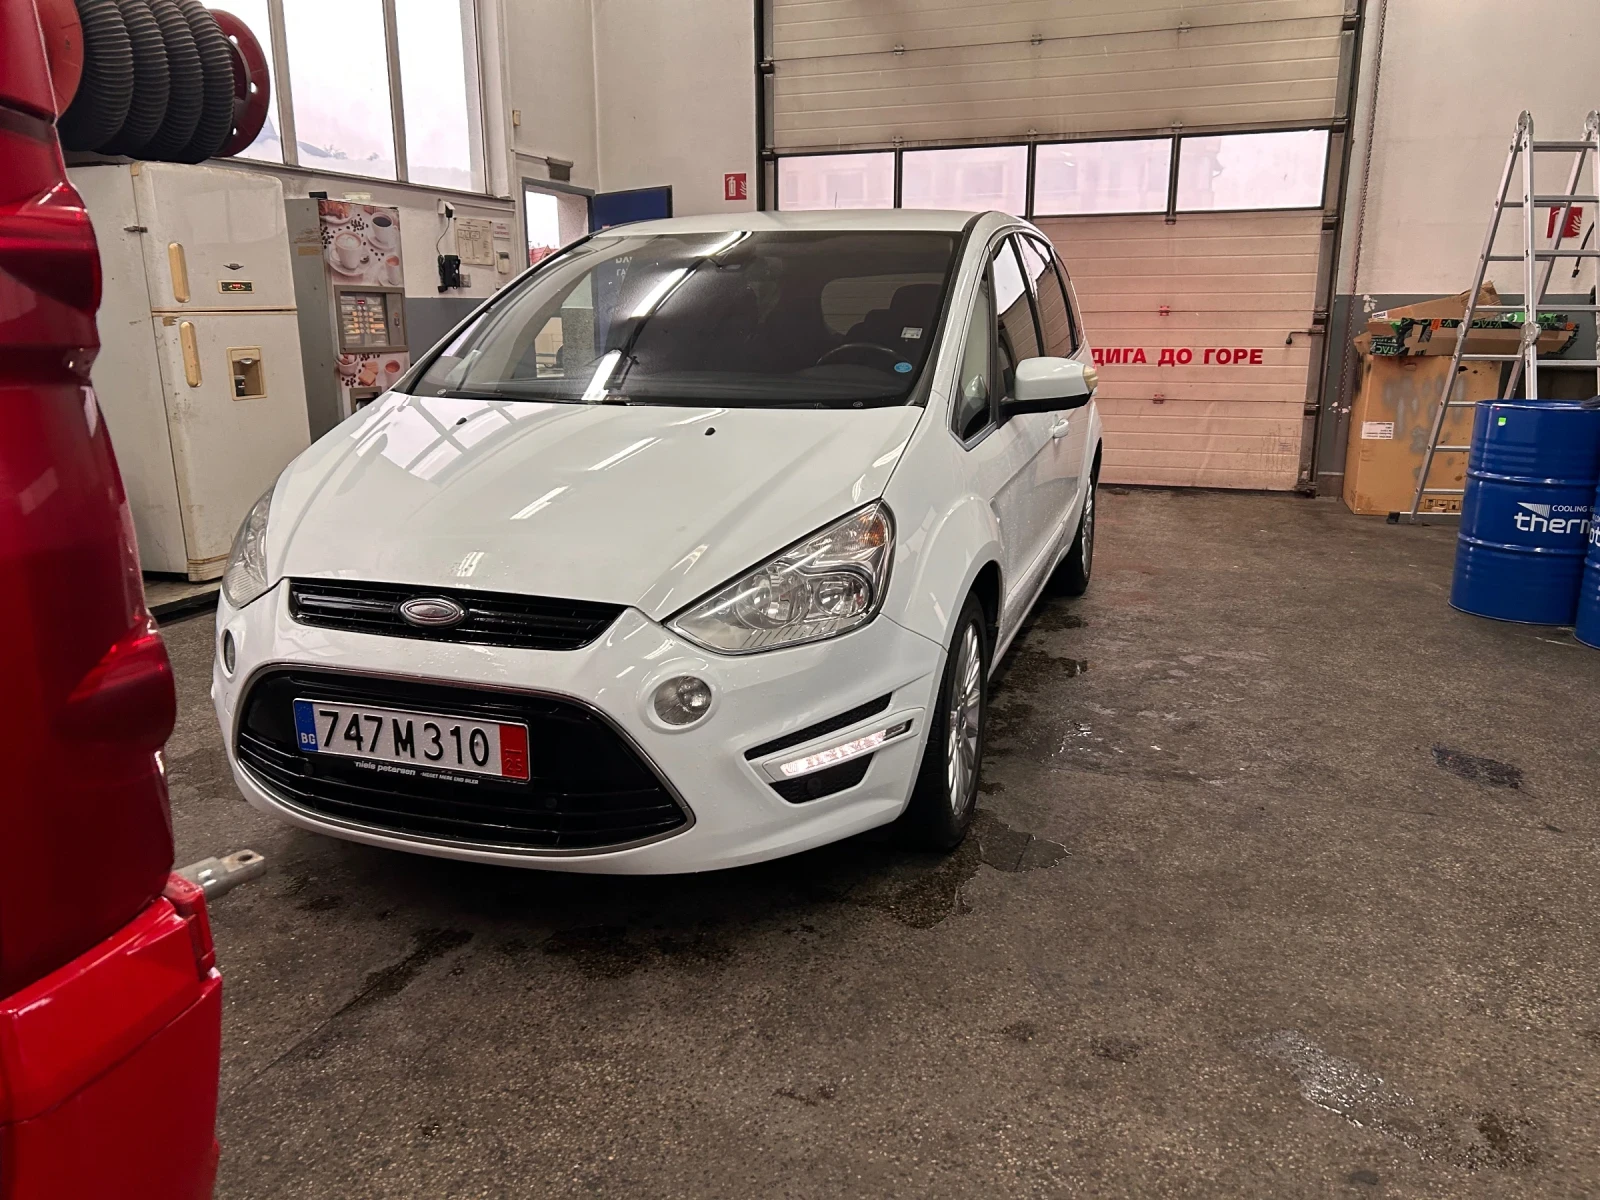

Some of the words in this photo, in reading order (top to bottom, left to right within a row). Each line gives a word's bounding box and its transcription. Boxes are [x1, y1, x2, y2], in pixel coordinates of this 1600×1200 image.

[1091, 348, 1147, 366] ДИГА
[1158, 348, 1192, 367] ДО
[1203, 348, 1263, 365] ГОРЕ
[1552, 504, 1588, 513] COOLING
[300, 732, 316, 745] BG
[354, 760, 376, 770] niels
[377, 764, 416, 776] petersen
[504, 757, 523, 772] 25
